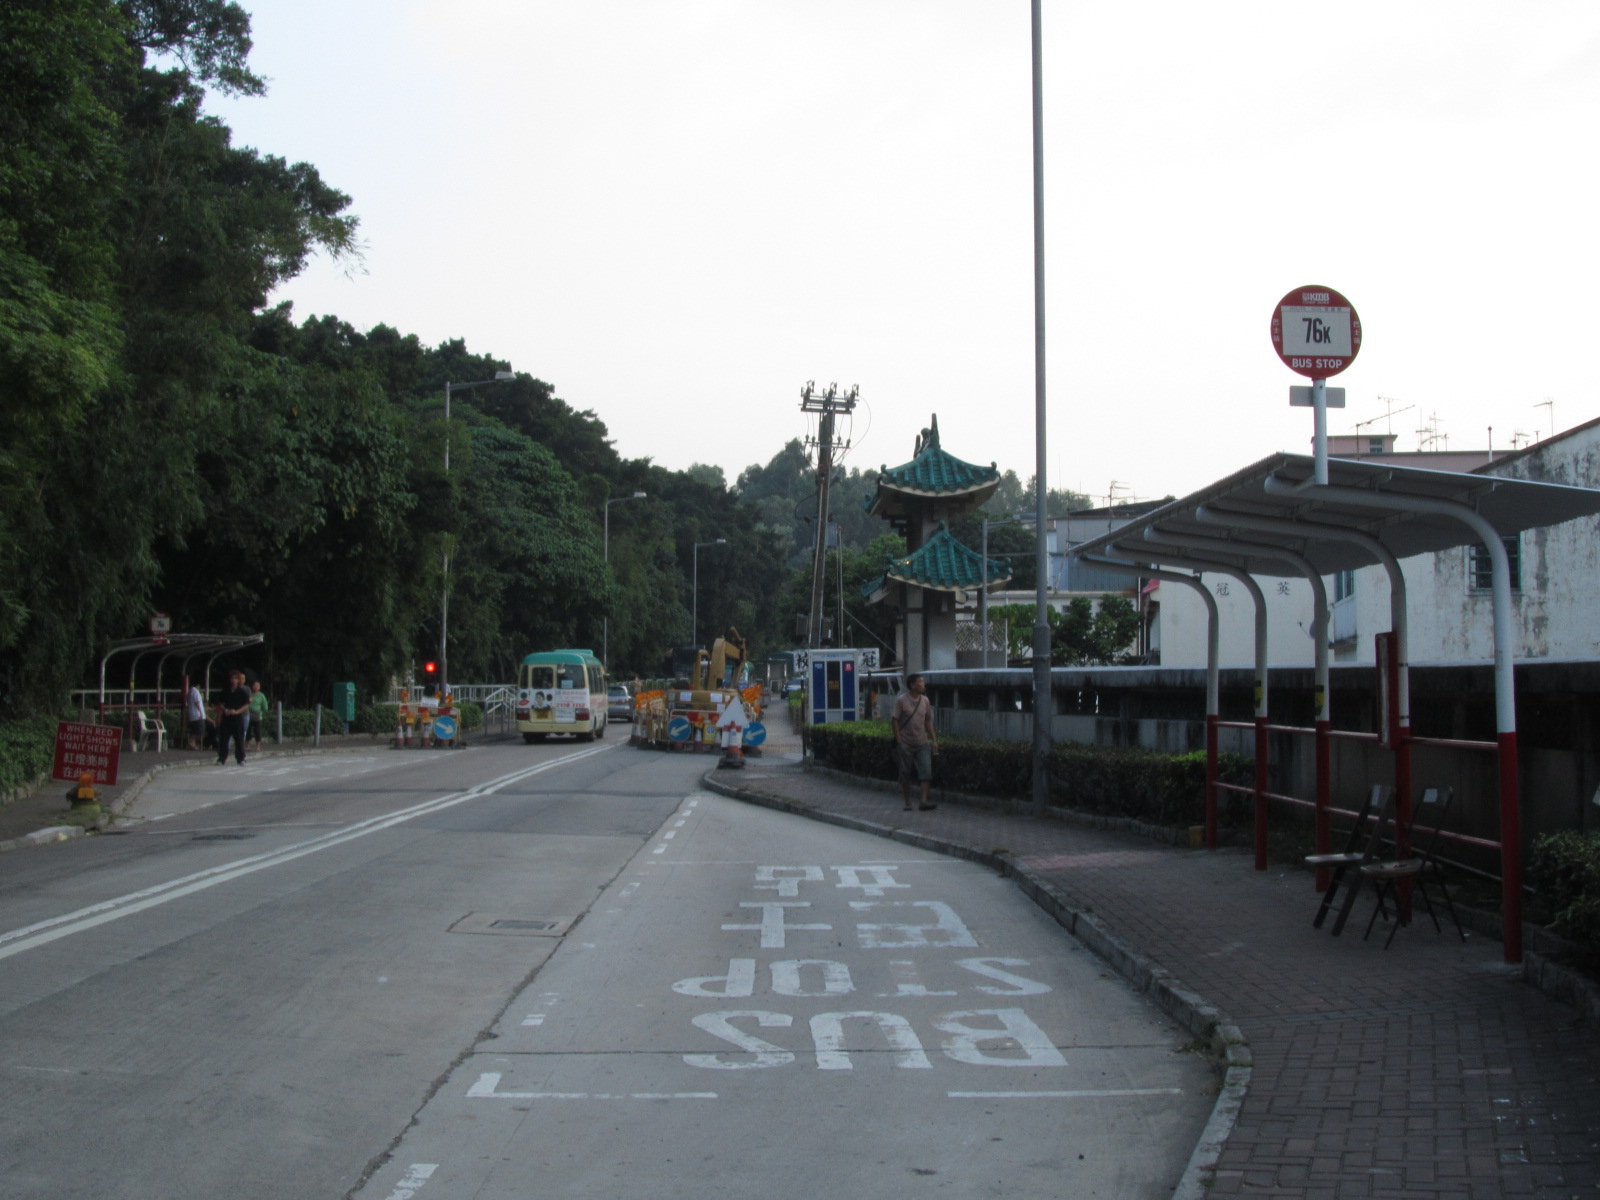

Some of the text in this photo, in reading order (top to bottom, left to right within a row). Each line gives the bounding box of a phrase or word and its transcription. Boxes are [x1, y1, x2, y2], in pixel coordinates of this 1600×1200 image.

[1302, 317, 1331, 344] 76K
[1292, 358, 1342, 369] BUS STOP
[67, 724, 113, 737] WHEN RED
[59, 733, 119, 745] LIGHT SHOWS
[64, 742, 111, 753] WAIT HERE
[671, 956, 1054, 998] STOP
[682, 1007, 1069, 1070] BUS
